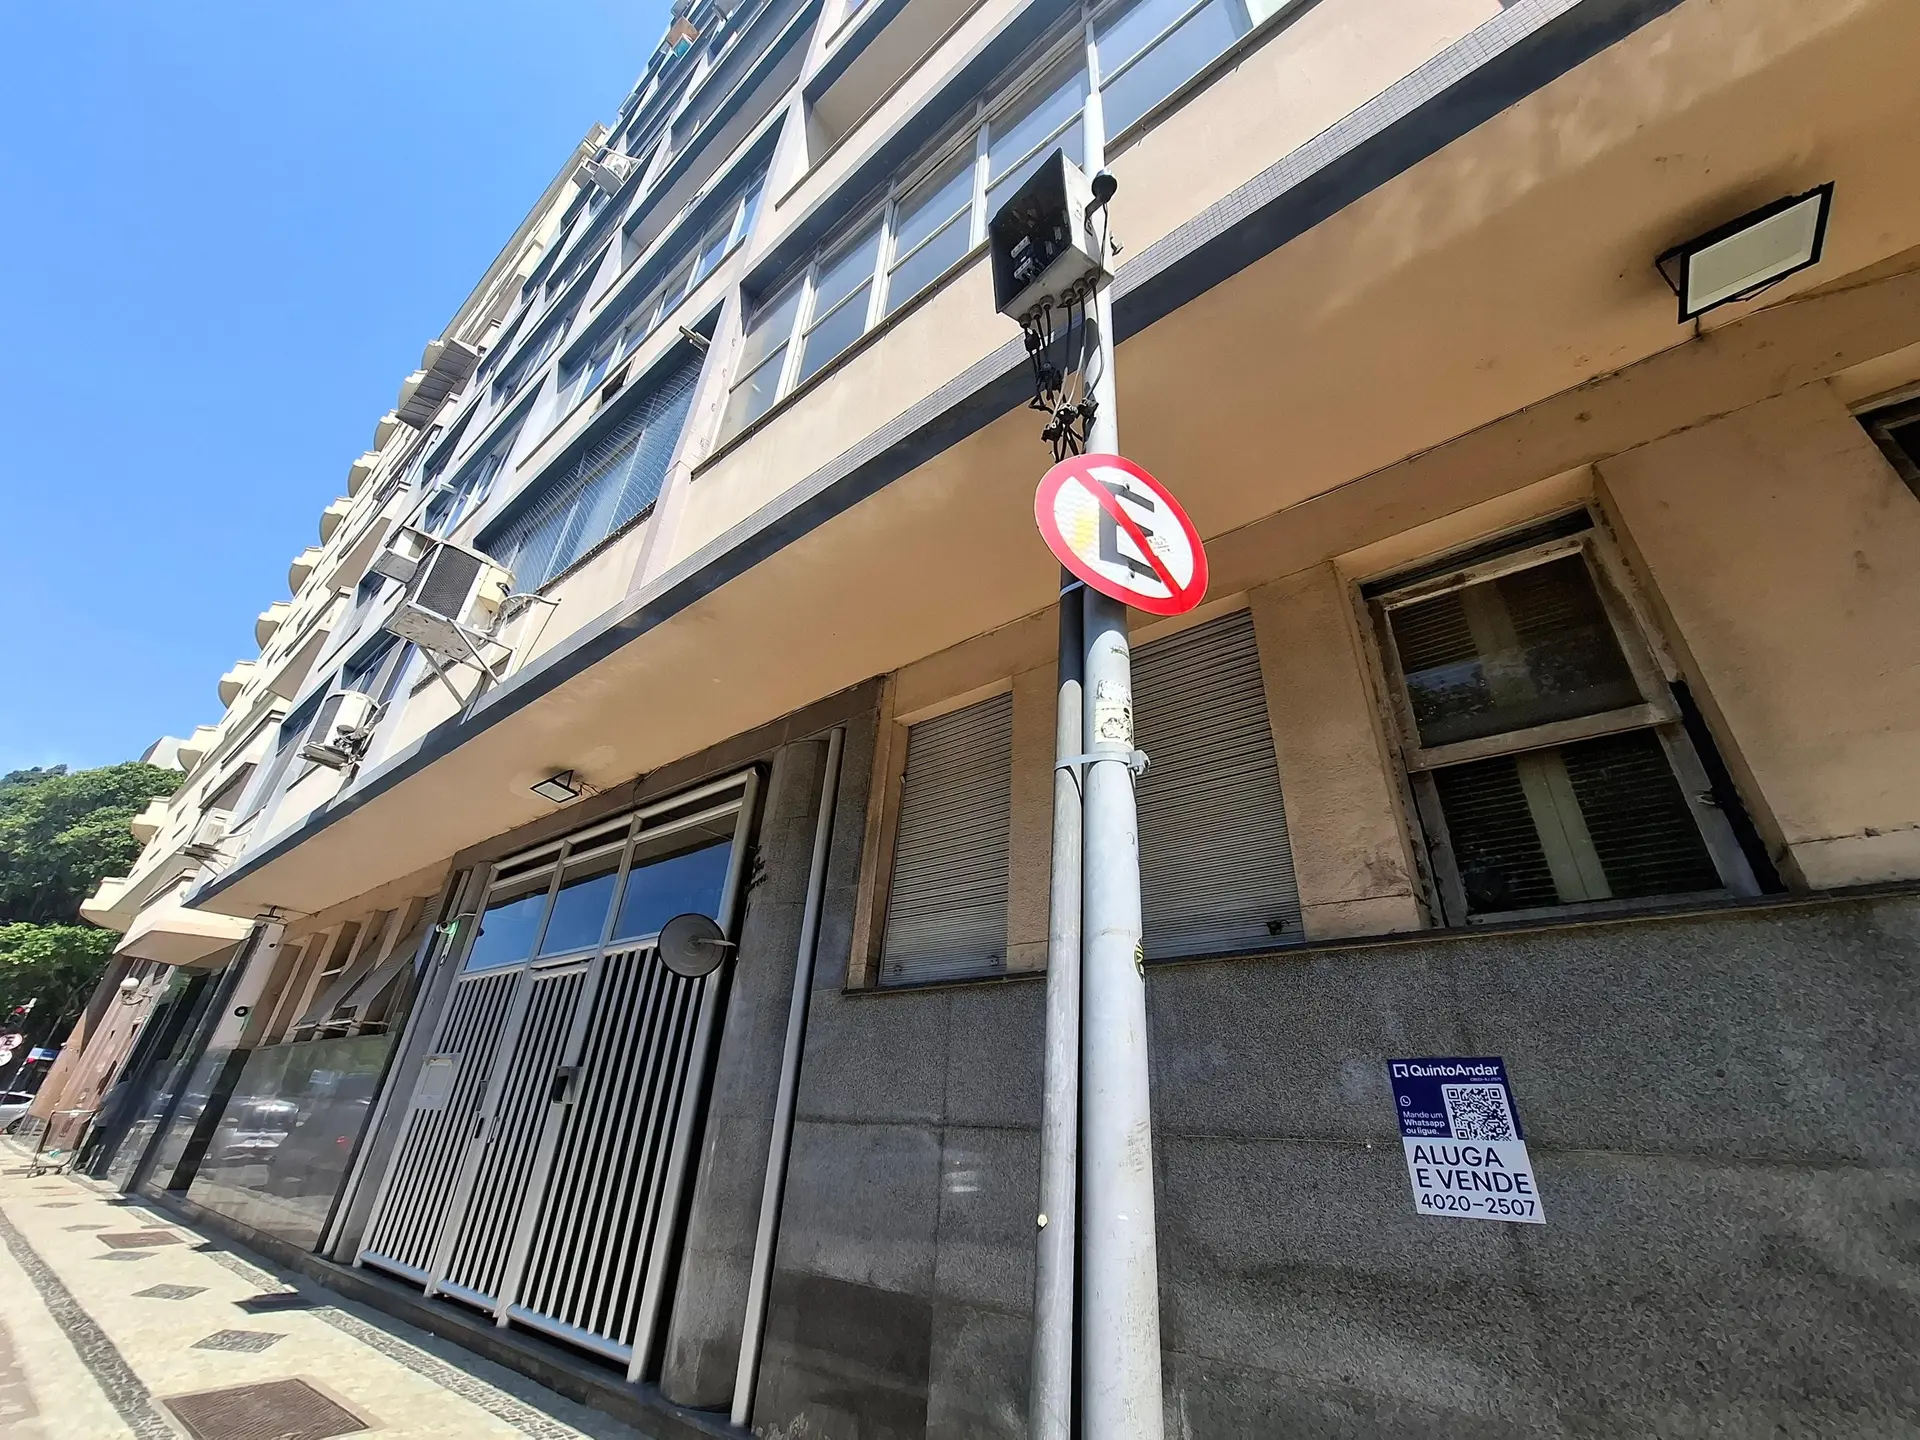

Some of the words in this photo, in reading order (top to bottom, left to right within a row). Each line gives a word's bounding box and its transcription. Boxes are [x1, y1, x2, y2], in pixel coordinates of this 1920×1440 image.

[1410, 1063, 1499, 1077] QuintoAndar
[1402, 1111, 1430, 1119] Mande
[1404, 1118, 1446, 1128] Whatsapp
[1413, 1144, 1504, 1168] ALUGA
[1416, 1168, 1433, 1188] E
[1435, 1169, 1532, 1194] VENDE
[1421, 1193, 1535, 1216] 4020-2507
